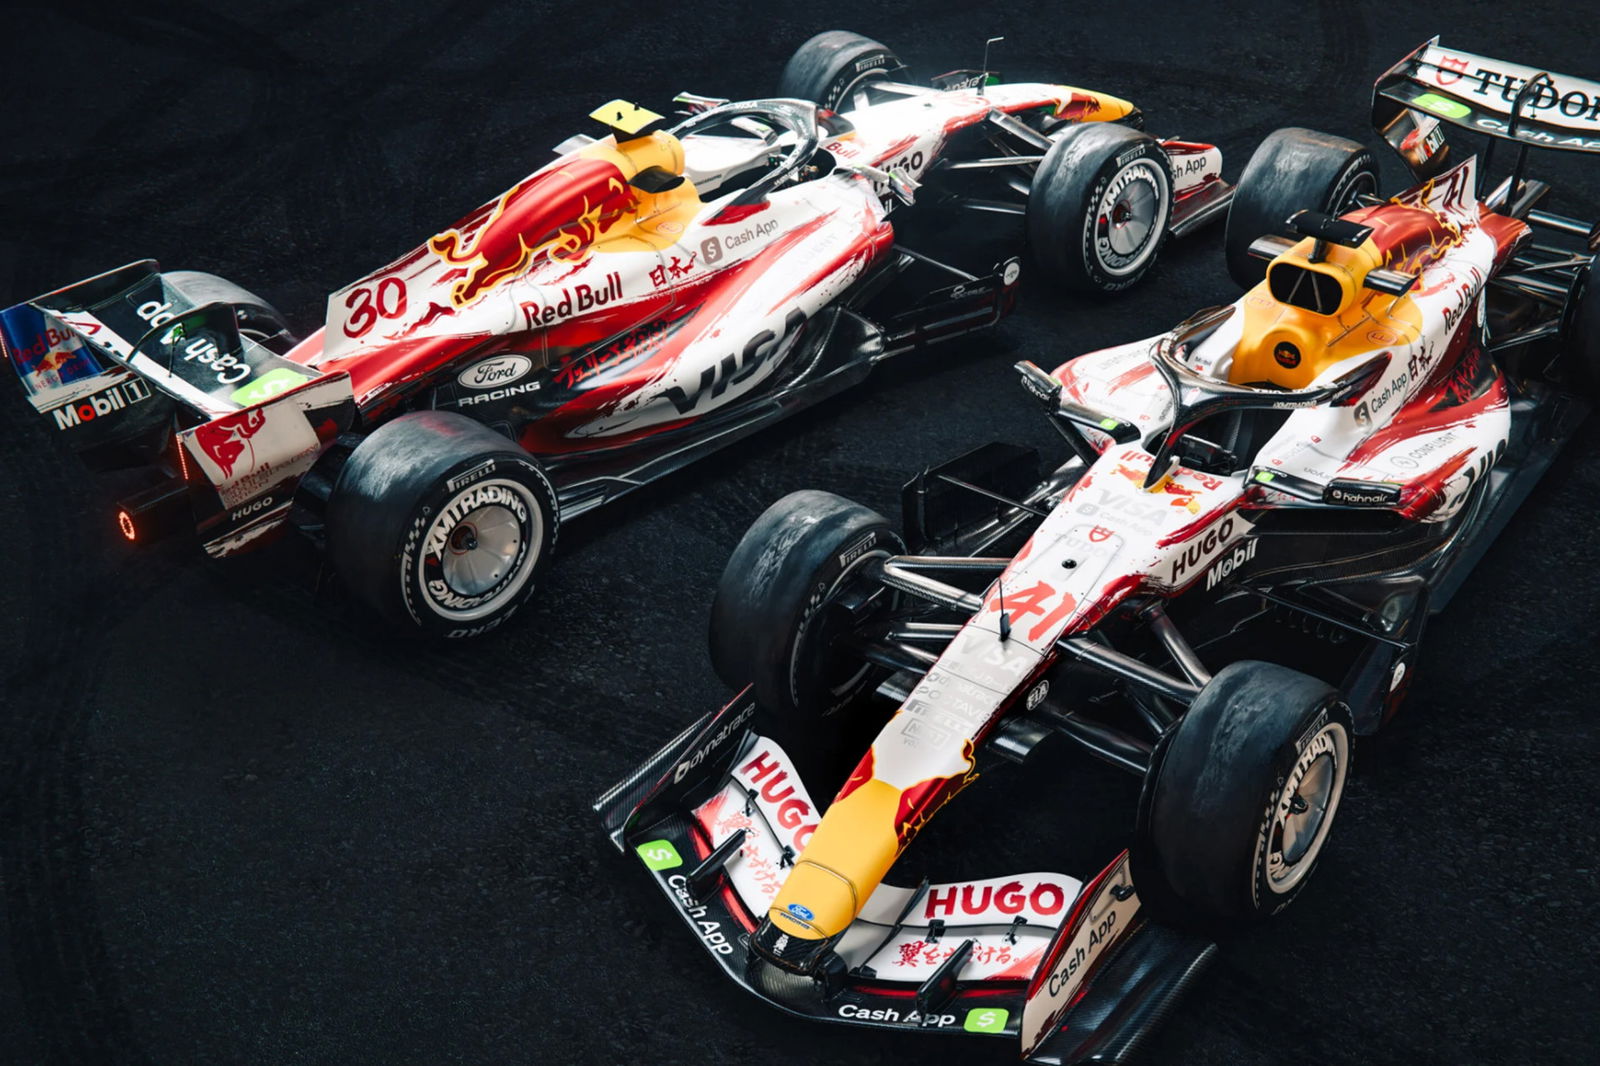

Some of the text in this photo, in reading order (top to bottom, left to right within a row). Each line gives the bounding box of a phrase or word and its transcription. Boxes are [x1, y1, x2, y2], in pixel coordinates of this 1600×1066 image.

[1185, 155, 1207, 177] App
[725, 217, 780, 251] Cash App
[342, 276, 408, 339] 30
[520, 271, 623, 329] Red Bull
[473, 360, 517, 384] Ford
[53, 388, 126, 431] Mobil
[458, 380, 541, 408] RACING
[1370, 385, 1392, 414] Cash
[1391, 372, 1408, 396] App
[447, 457, 497, 493] PIRELLI
[1120, 449, 1155, 469] ull
[231, 496, 274, 522] HUGO
[1170, 516, 1235, 584] HUGO
[1205, 536, 1259, 593] Mobil
[988, 580, 1078, 643] 41
[688, 701, 756, 769] dynatrace
[924, 880, 1066, 919] HUGO
[700, 918, 734, 956] App
[1047, 909, 1118, 999] Cash App
[837, 1003, 900, 1024] Cash
